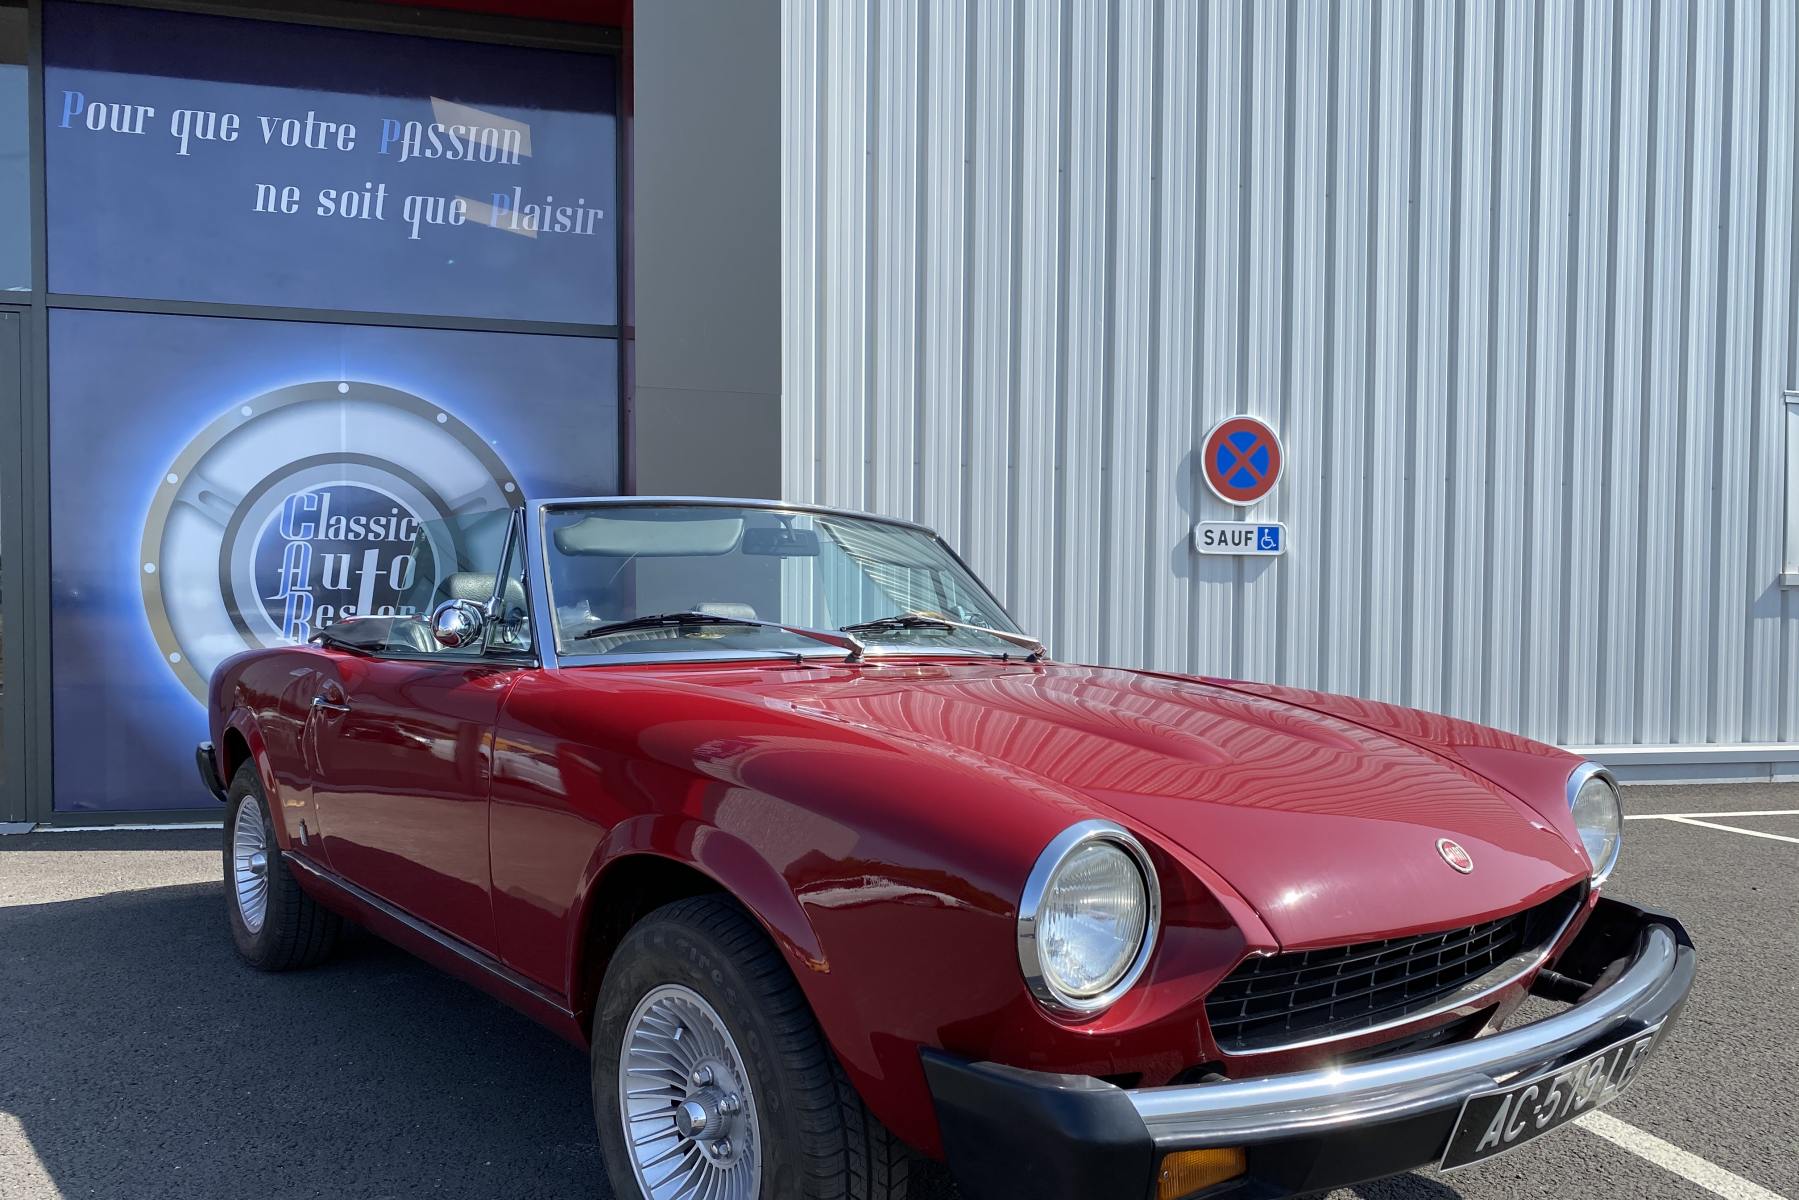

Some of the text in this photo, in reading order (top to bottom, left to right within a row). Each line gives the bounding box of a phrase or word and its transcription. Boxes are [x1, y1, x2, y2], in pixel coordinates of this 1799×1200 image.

[58, 90, 155, 136] Pour
[170, 109, 240, 155] que
[257, 111, 356, 151] votre
[252, 182, 604, 239] ne soit que Plaisir
[280, 492, 418, 541] Classic
[1204, 529, 1254, 546] SAUF
[266, 541, 416, 616] Auto
